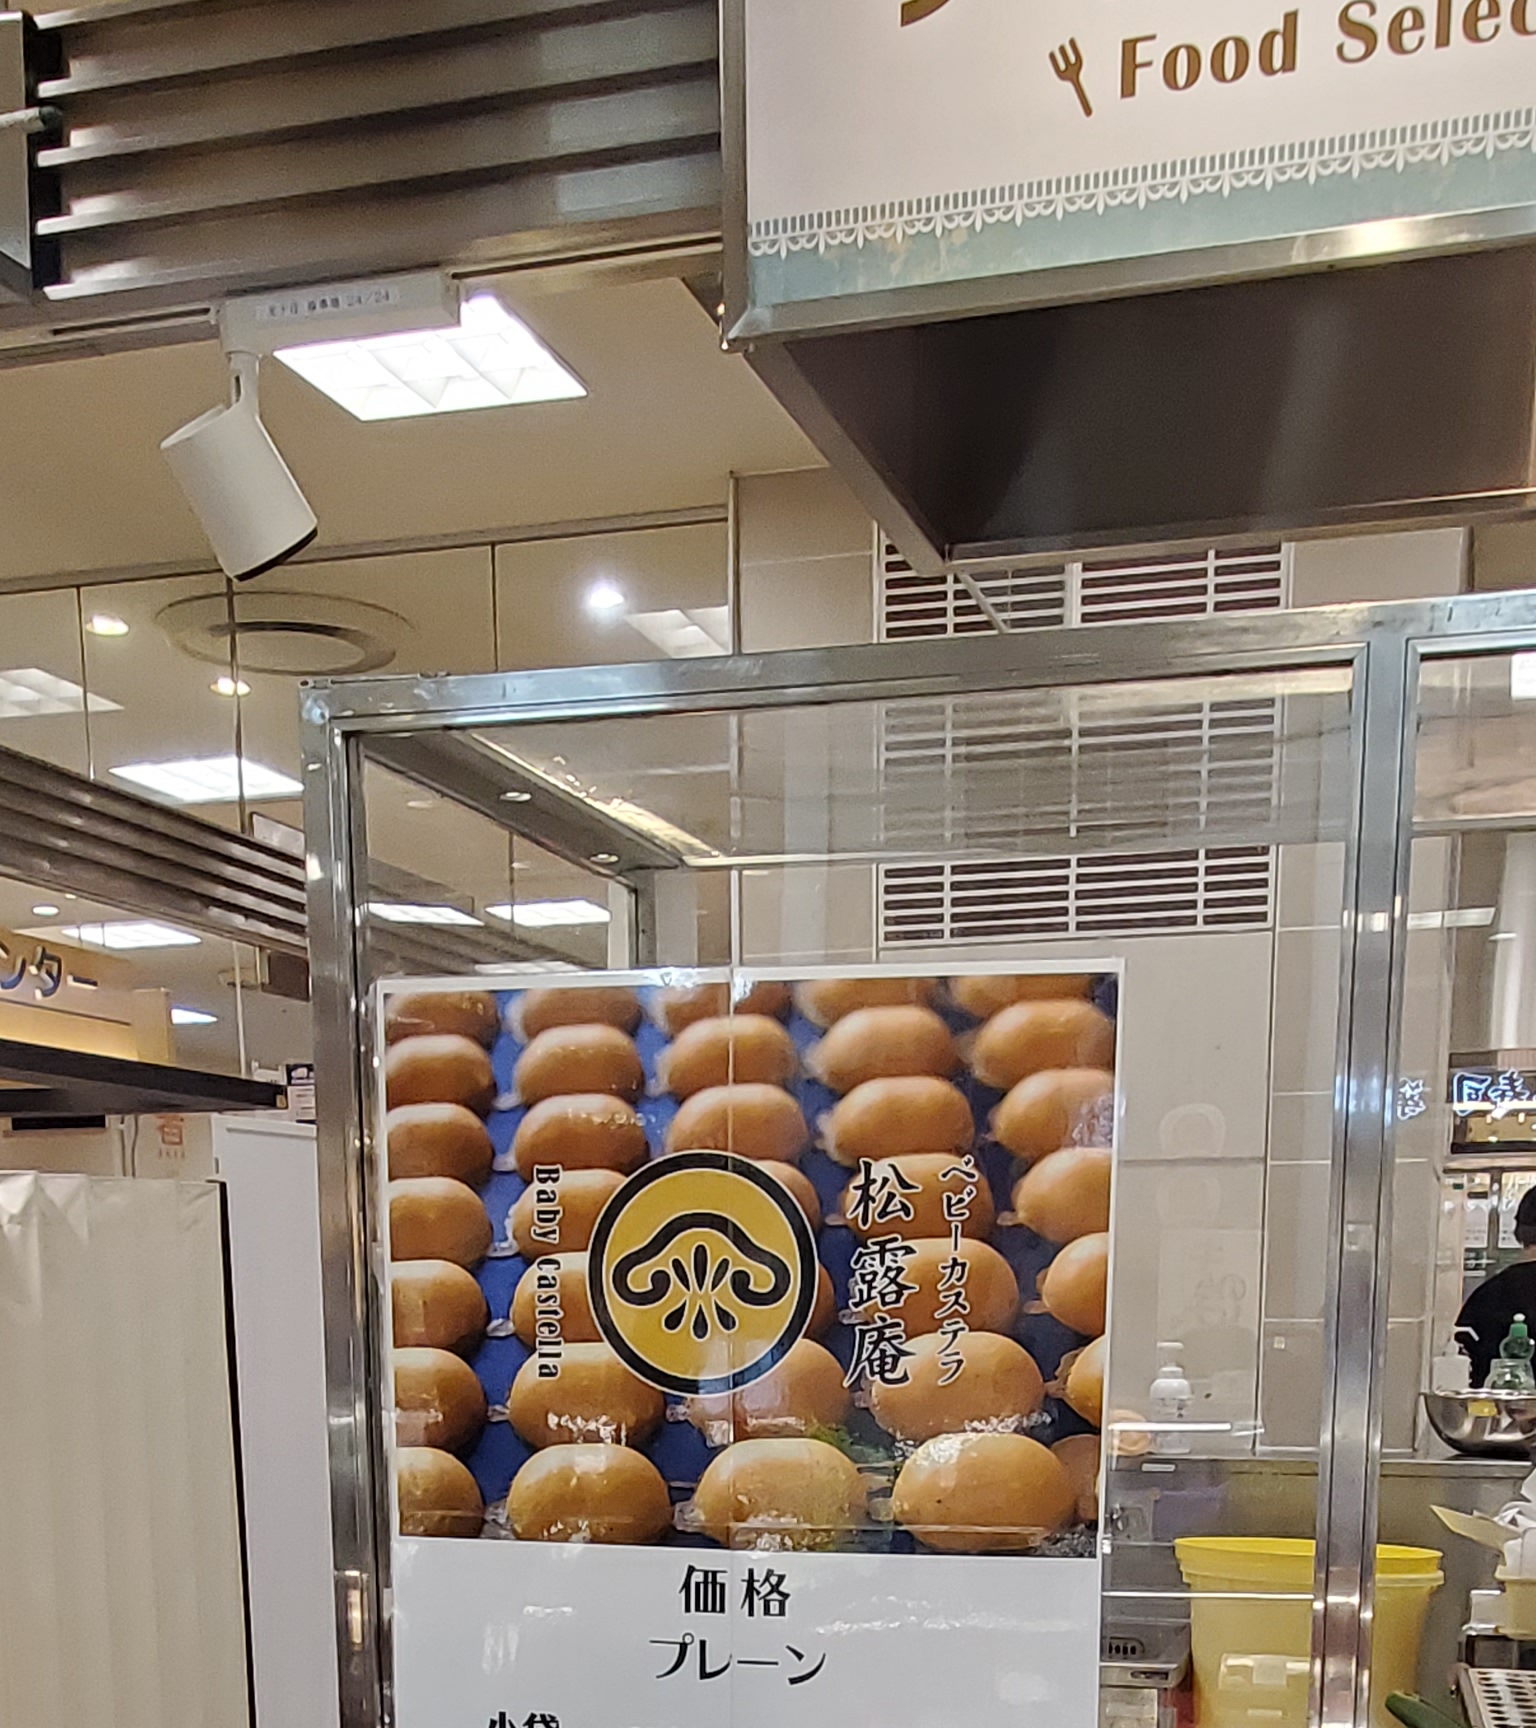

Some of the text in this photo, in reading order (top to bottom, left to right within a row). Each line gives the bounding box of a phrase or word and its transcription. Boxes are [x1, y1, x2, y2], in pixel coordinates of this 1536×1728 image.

[1119, 9, 1299, 100] Food
[532, 1165, 563, 1380] Baby Castella
[845, 1157, 922, 1390] 松露庵
[937, 1155, 975, 1387] ベビーカステラ
[649, 1632, 827, 1686] プレーン
[679, 1564, 792, 1619] 価格
